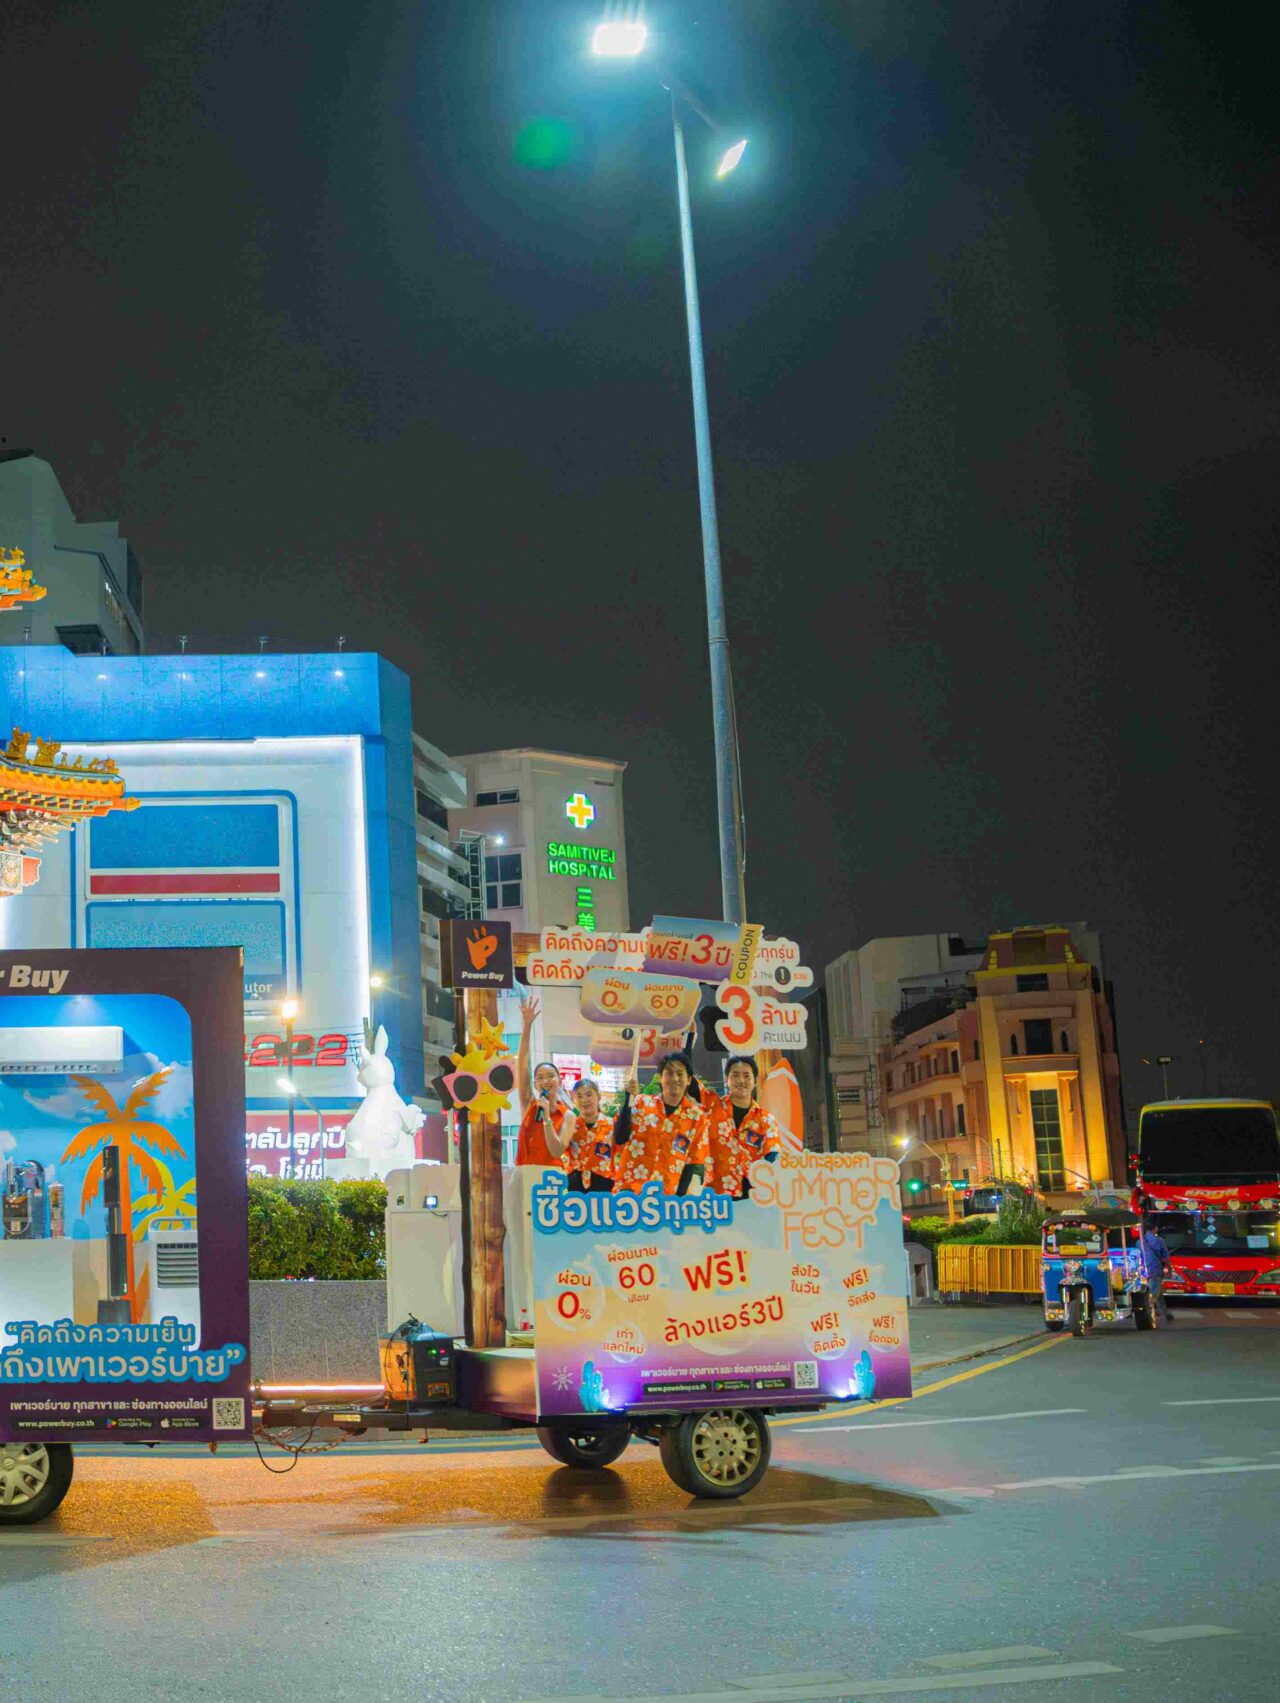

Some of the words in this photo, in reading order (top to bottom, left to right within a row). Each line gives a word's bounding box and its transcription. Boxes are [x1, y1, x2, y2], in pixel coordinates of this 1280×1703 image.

[548, 842, 616, 864] SAMITIVEJ
[548, 860, 617, 881] HOSPITAL
[736, 929, 755, 979] COUPON
[9, 965, 70, 994] Buy
[461, 971, 488, 980] Power
[488, 972, 505, 982] Buy
[244, 982, 273, 993] utor
[650, 994, 679, 1009] 60
[721, 986, 754, 1044] 3
[242, 1033, 348, 1066] 222
[607, 1246, 658, 1262] ผ่อนนาน
[557, 1268, 592, 1286] ผ่อน
[618, 1263, 655, 1289] 60
[791, 1264, 820, 1278] ส่งไว
[842, 1268, 869, 1289] ฟรี!
[790, 1279, 821, 1294] ในวัน
[811, 1312, 839, 1332] ฟรี!
[872, 1315, 895, 1329] ฟรี!
[10, 1399, 71, 1411] เพาเวอร์บาย
[73, 1401, 112, 1413] ทุกสาขา
[113, 1401, 130, 1410] และ
[131, 1398, 208, 1410] ช่องทางออนไลน์
[18, 1419, 95, 1428] www.powerbuy.co.th
